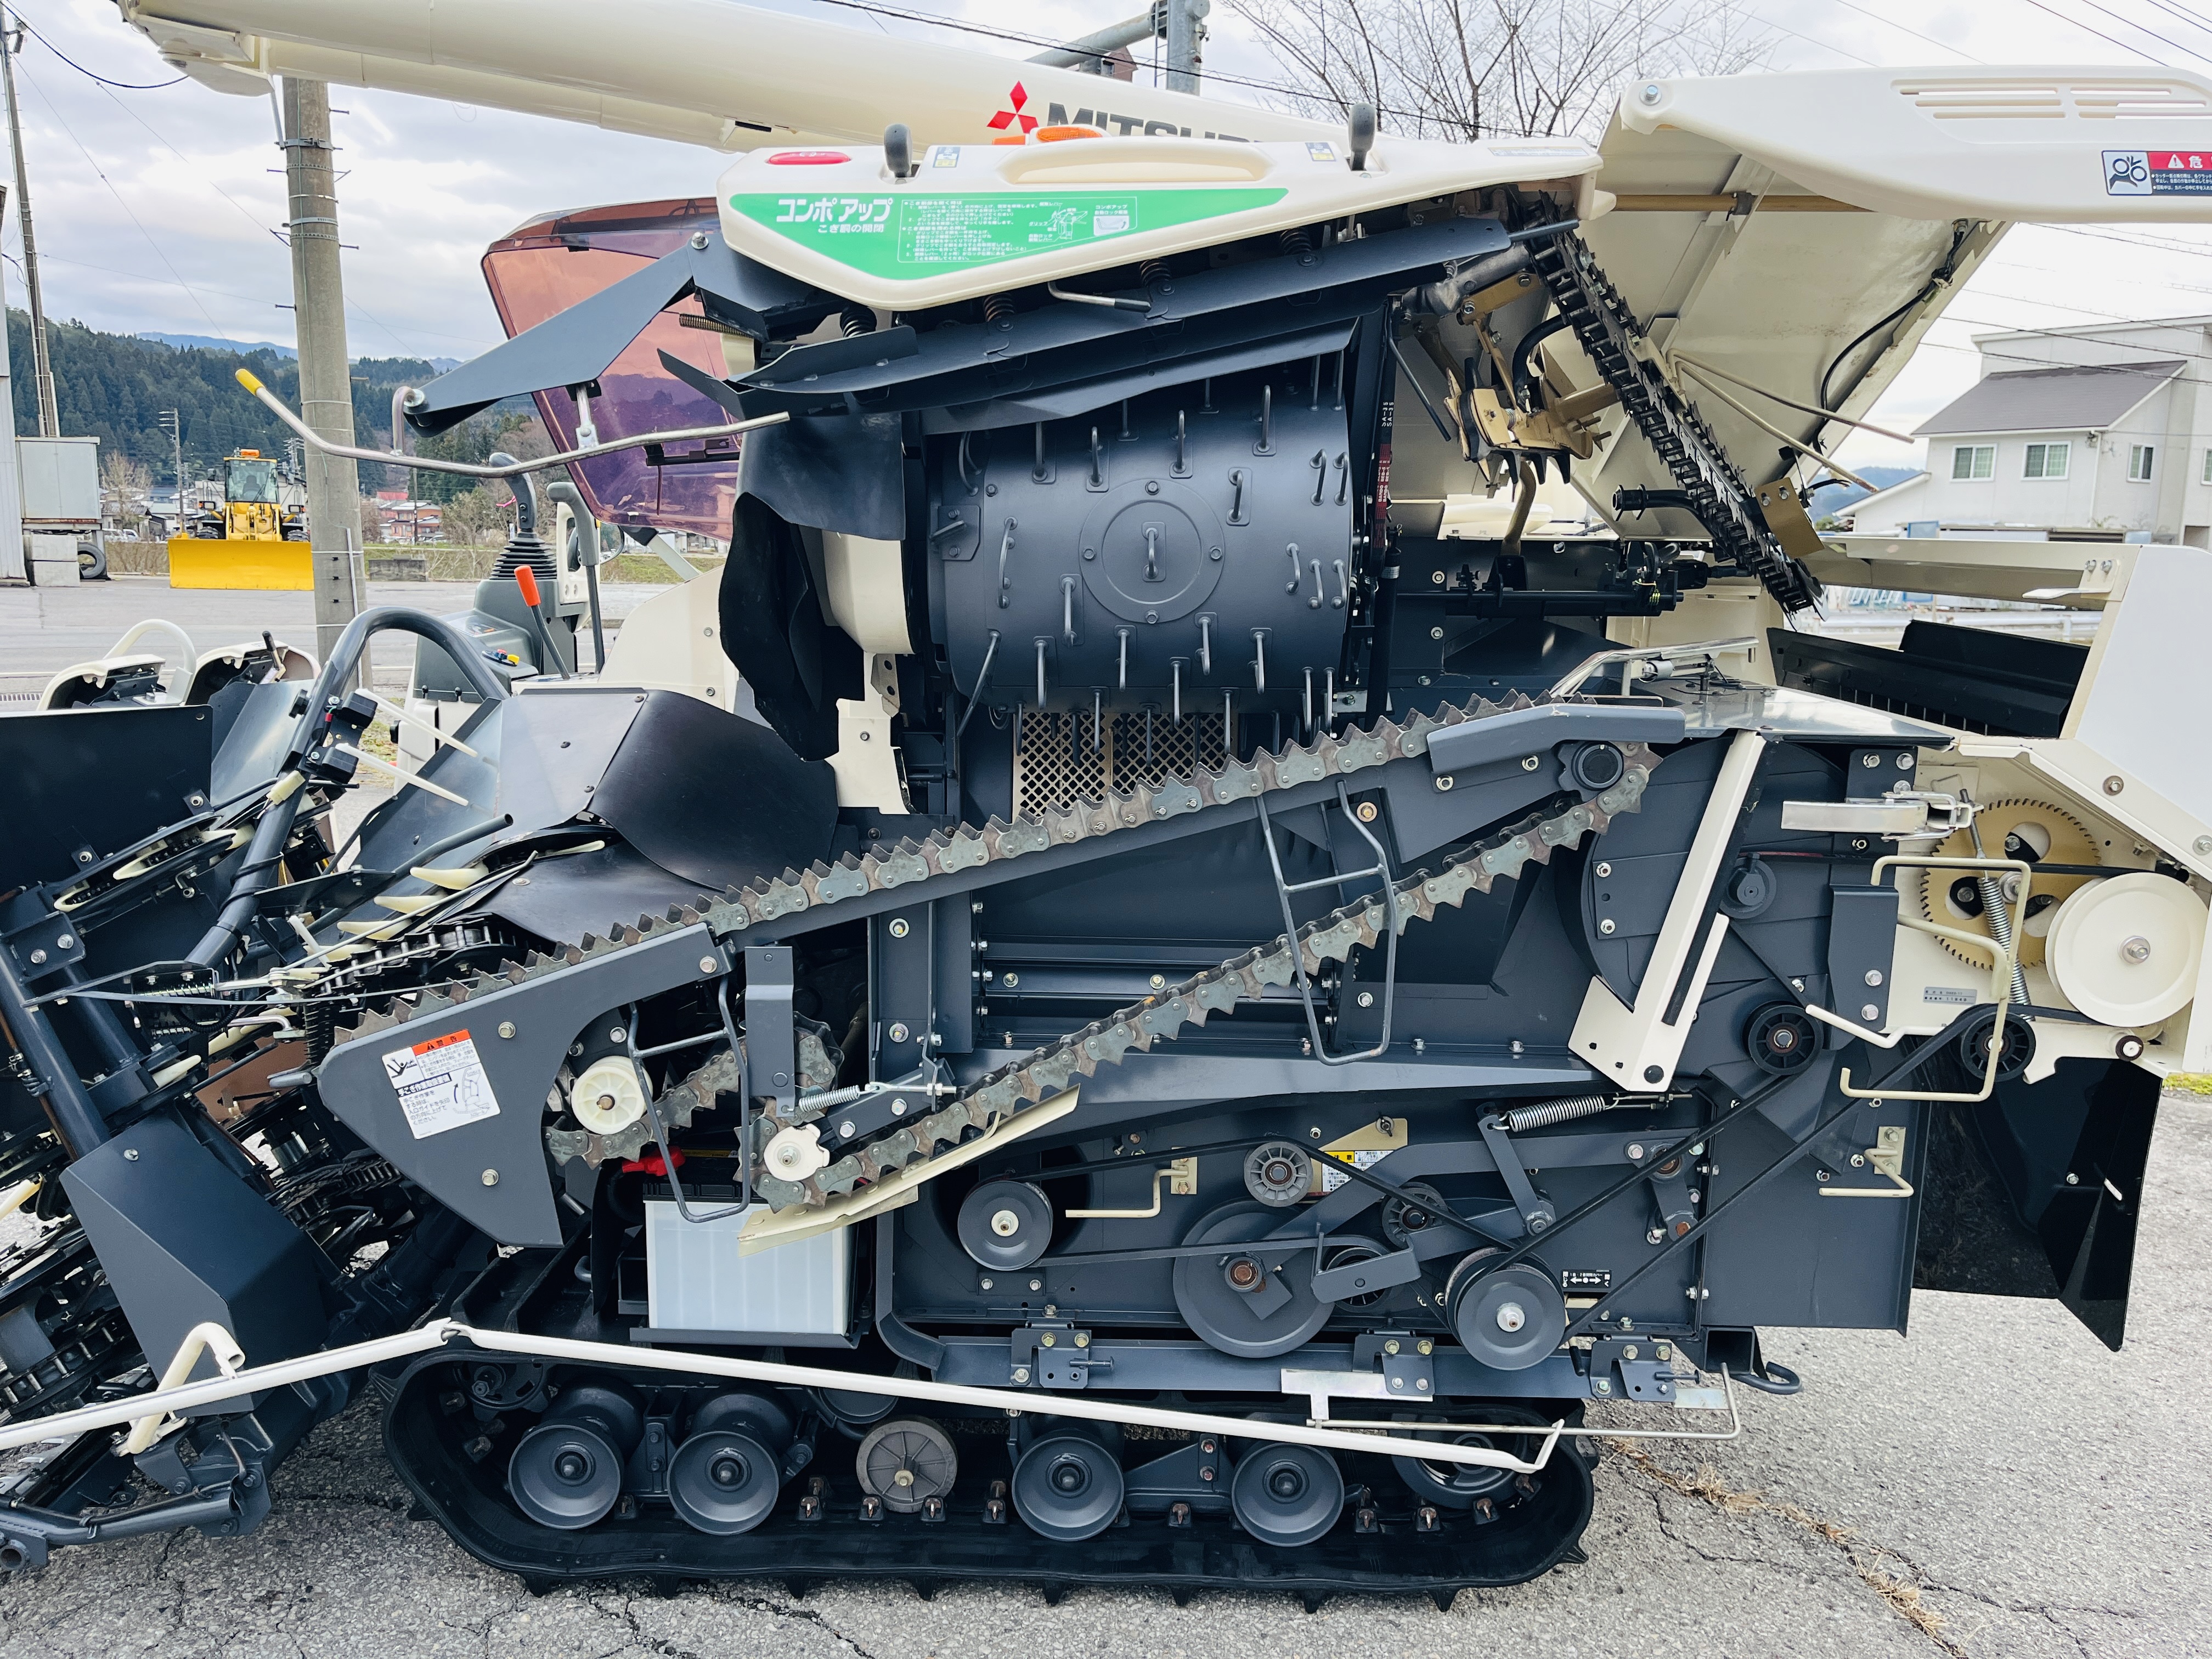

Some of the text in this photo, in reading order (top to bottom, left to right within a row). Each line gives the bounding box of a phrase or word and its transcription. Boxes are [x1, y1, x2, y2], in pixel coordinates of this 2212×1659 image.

[2188, 155, 2212, 169] 危
[776, 198, 893, 222] コンポアップ
[818, 224, 884, 233] こぎ胴の開閉
